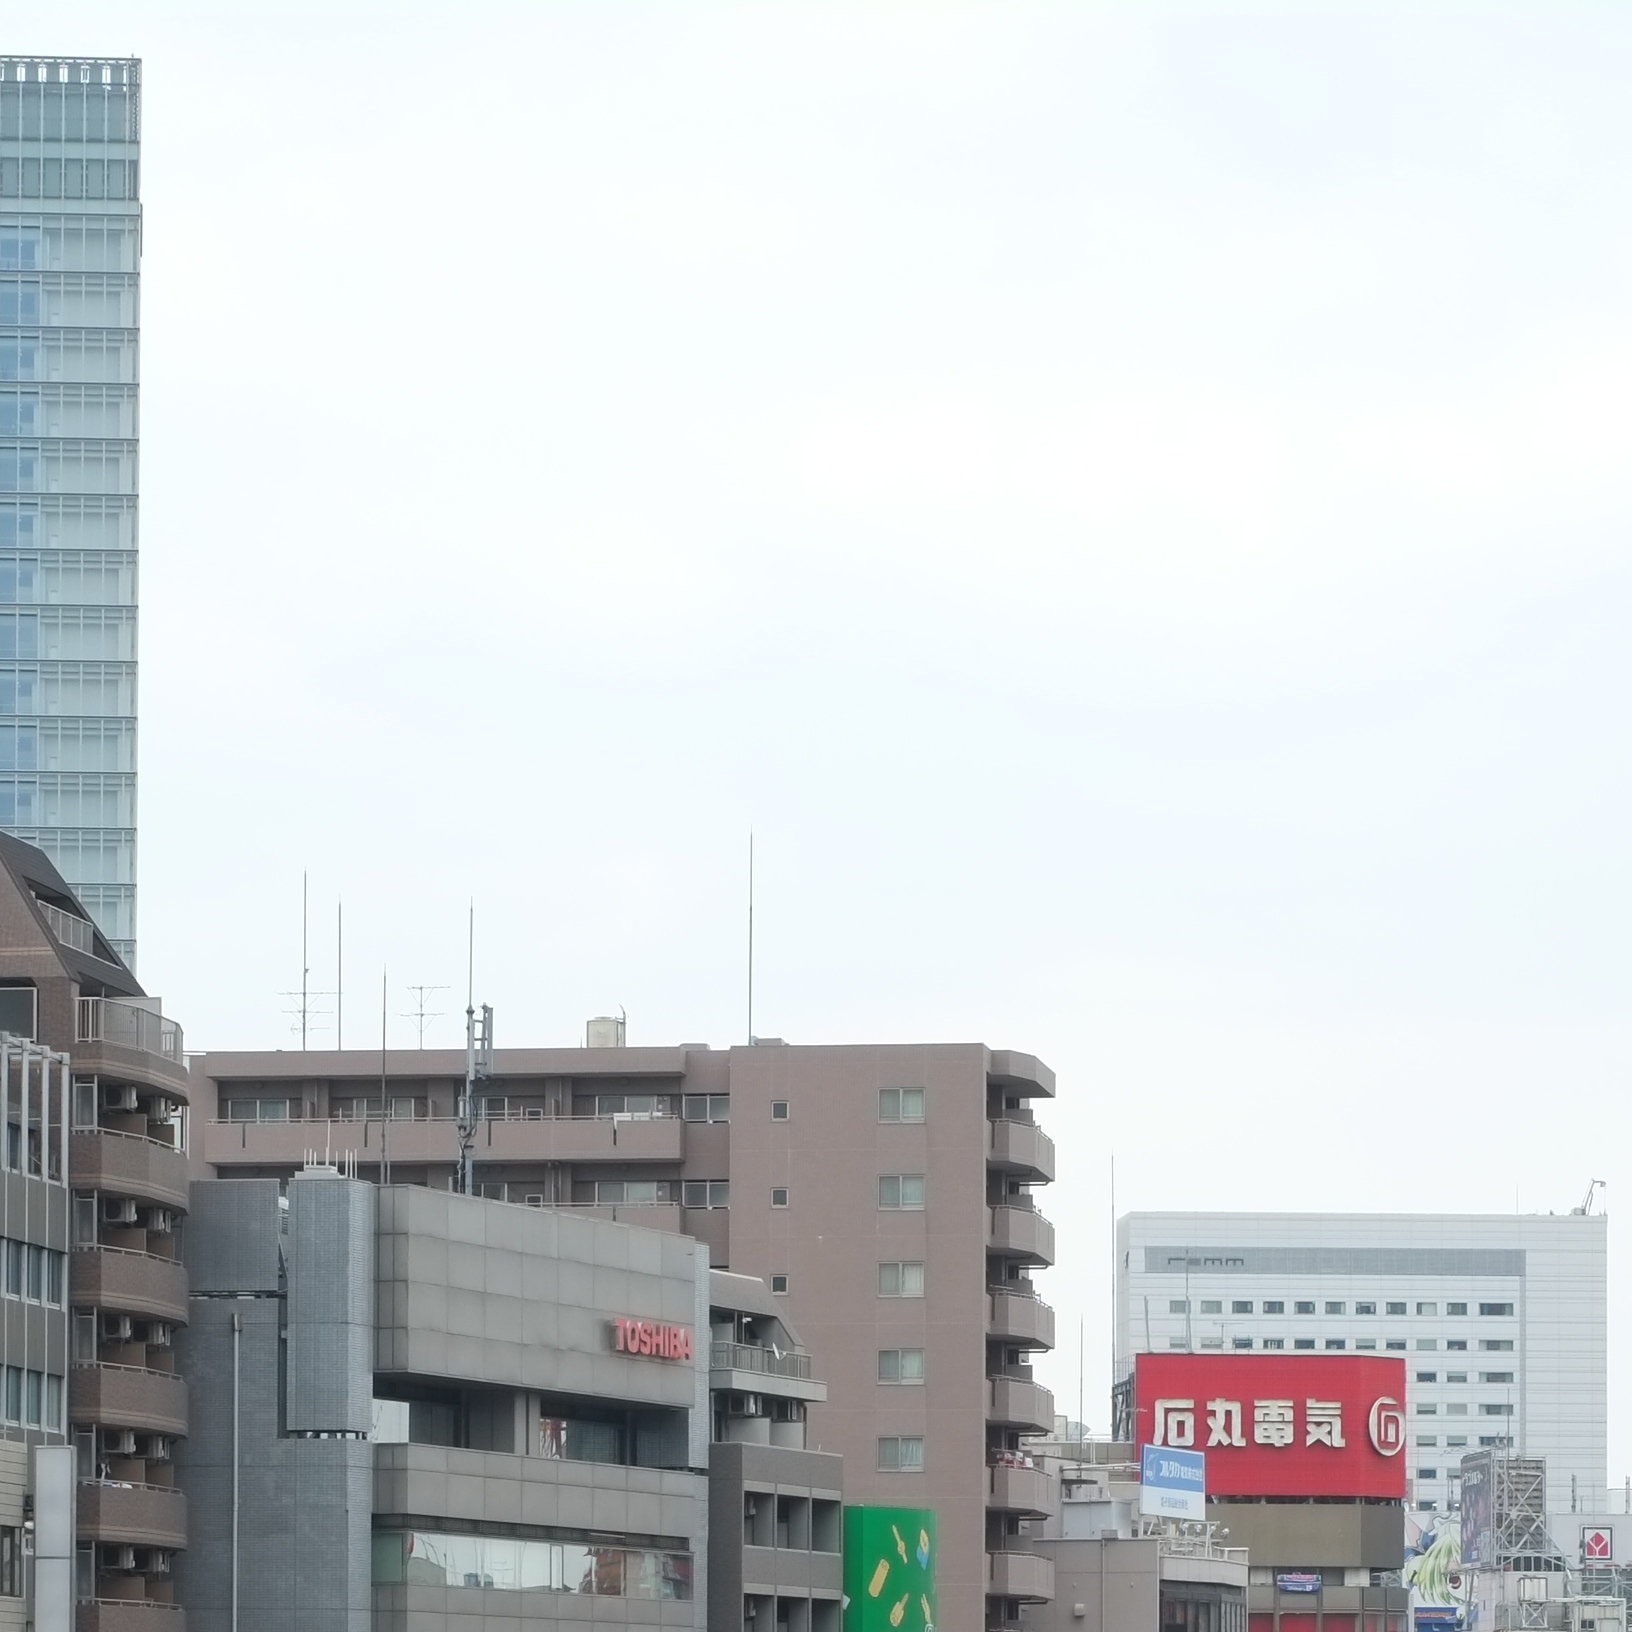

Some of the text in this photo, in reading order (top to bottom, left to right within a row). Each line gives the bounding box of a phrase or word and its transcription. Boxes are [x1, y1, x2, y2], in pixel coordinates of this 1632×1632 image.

[612, 1316, 693, 1361] TOSHIBA
[1152, 1398, 1346, 1448] 石丸電気
